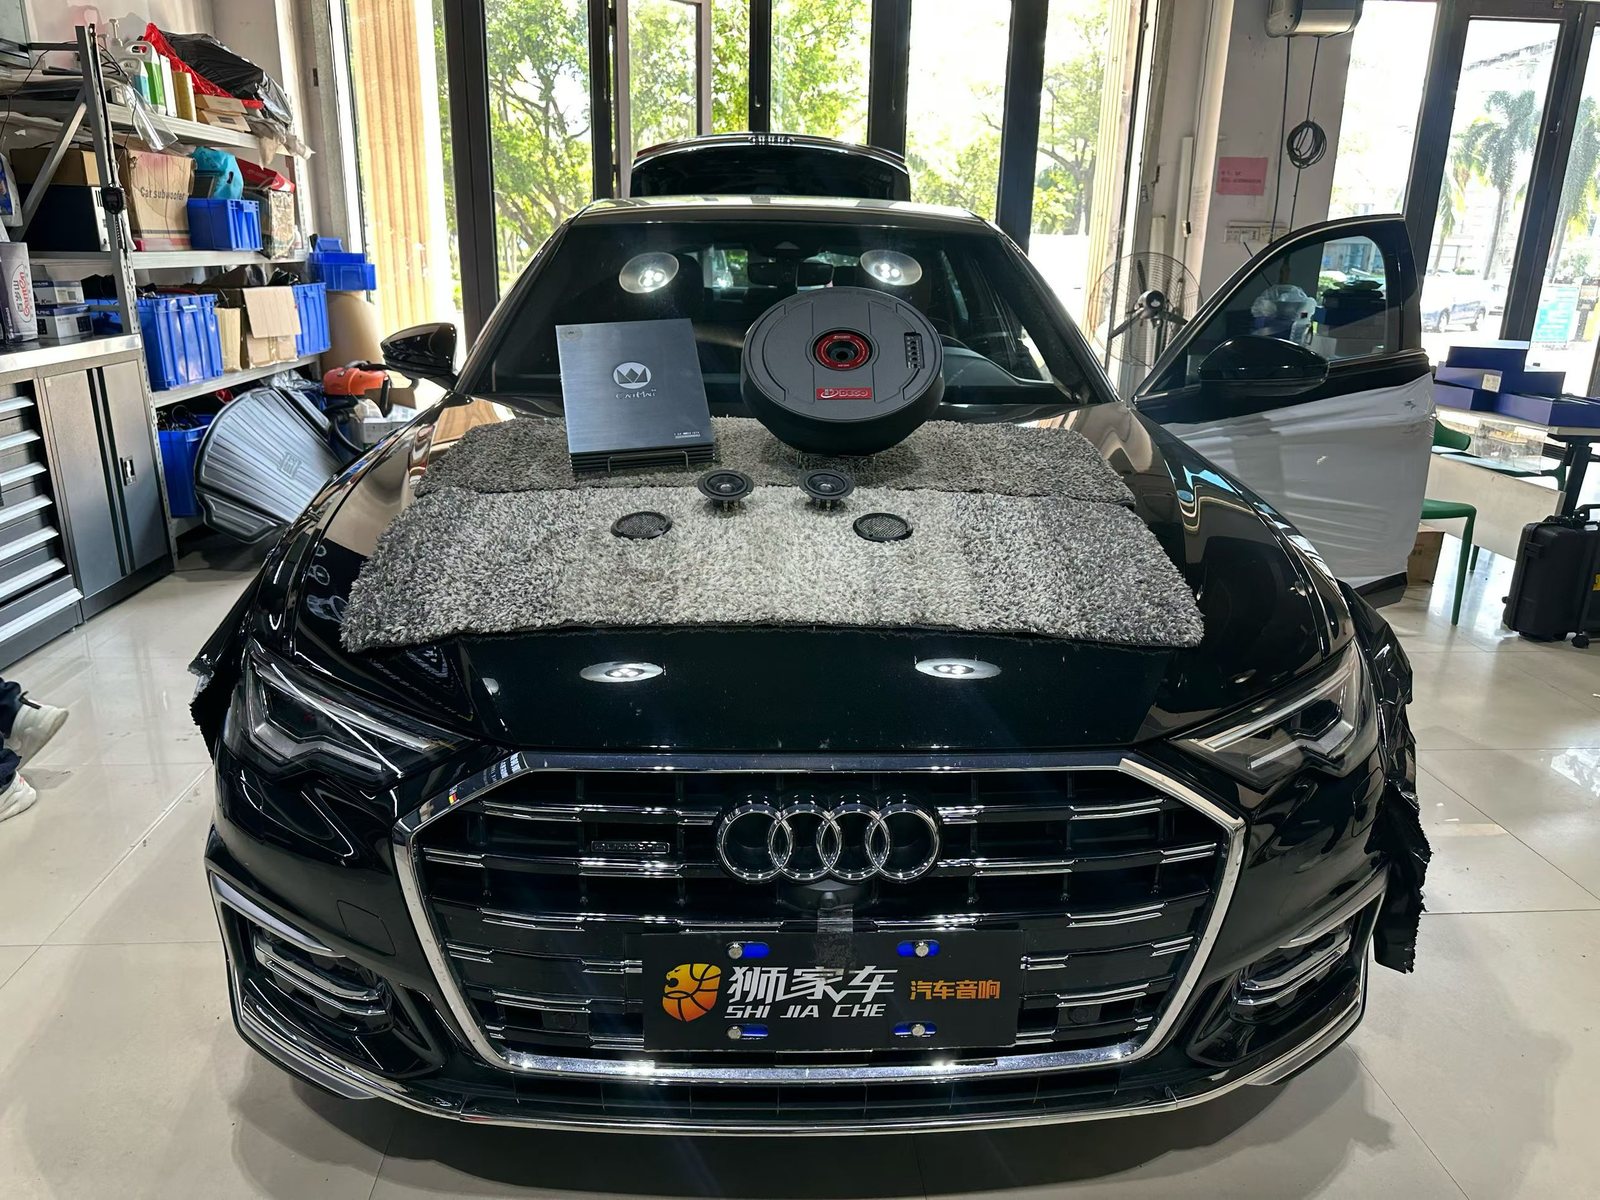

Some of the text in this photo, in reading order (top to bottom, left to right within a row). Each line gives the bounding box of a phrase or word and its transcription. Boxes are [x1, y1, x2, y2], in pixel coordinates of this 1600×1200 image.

[726, 965, 898, 1005] 狮家车
[910, 979, 1001, 1000] 汽车音响
[724, 1003, 887, 1019] SHI JIA CHE
